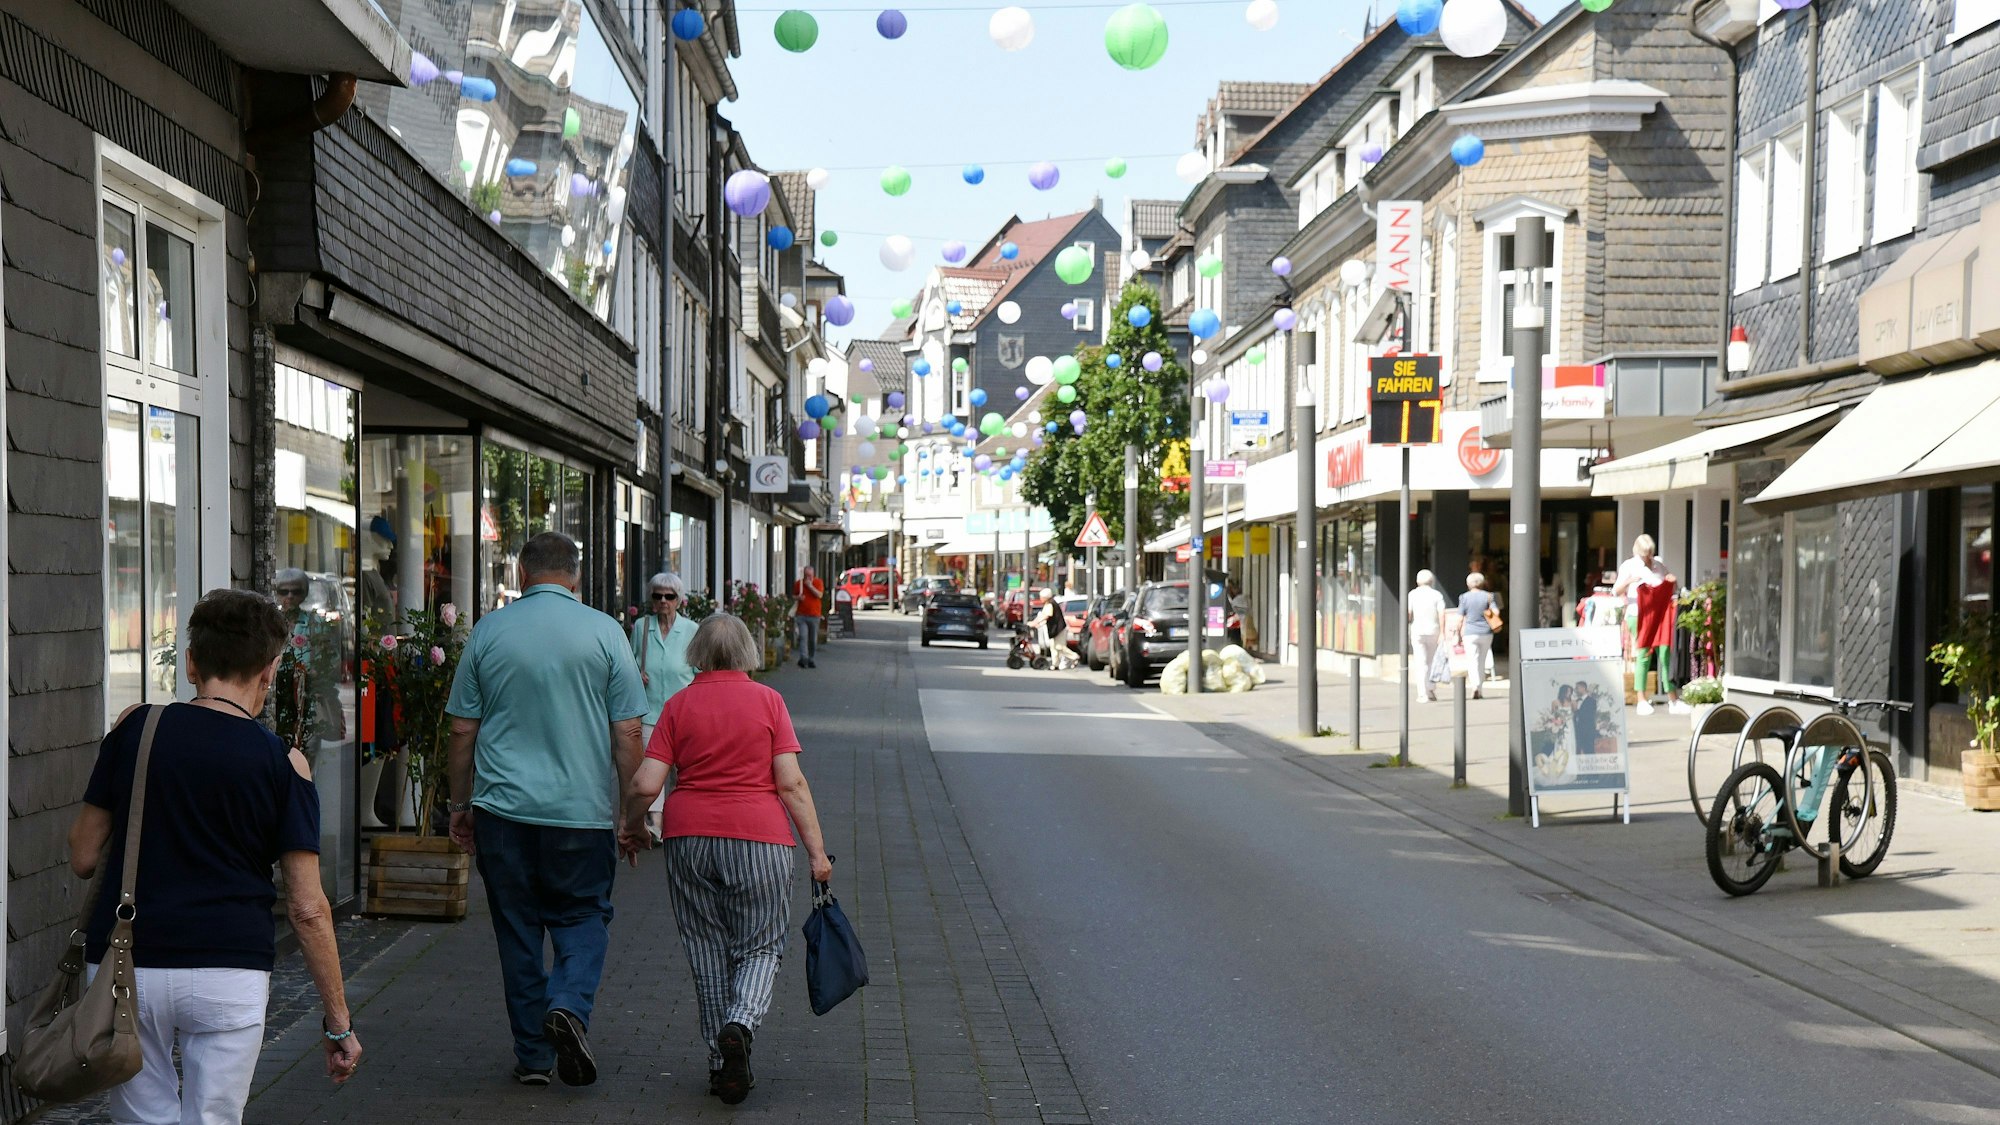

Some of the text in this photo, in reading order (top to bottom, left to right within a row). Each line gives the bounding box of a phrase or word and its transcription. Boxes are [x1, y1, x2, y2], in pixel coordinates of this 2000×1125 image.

[1393, 360, 1417, 377] SIE
[1377, 377, 1433, 393] FAHREN
[1400, 400, 1442, 443] 17
